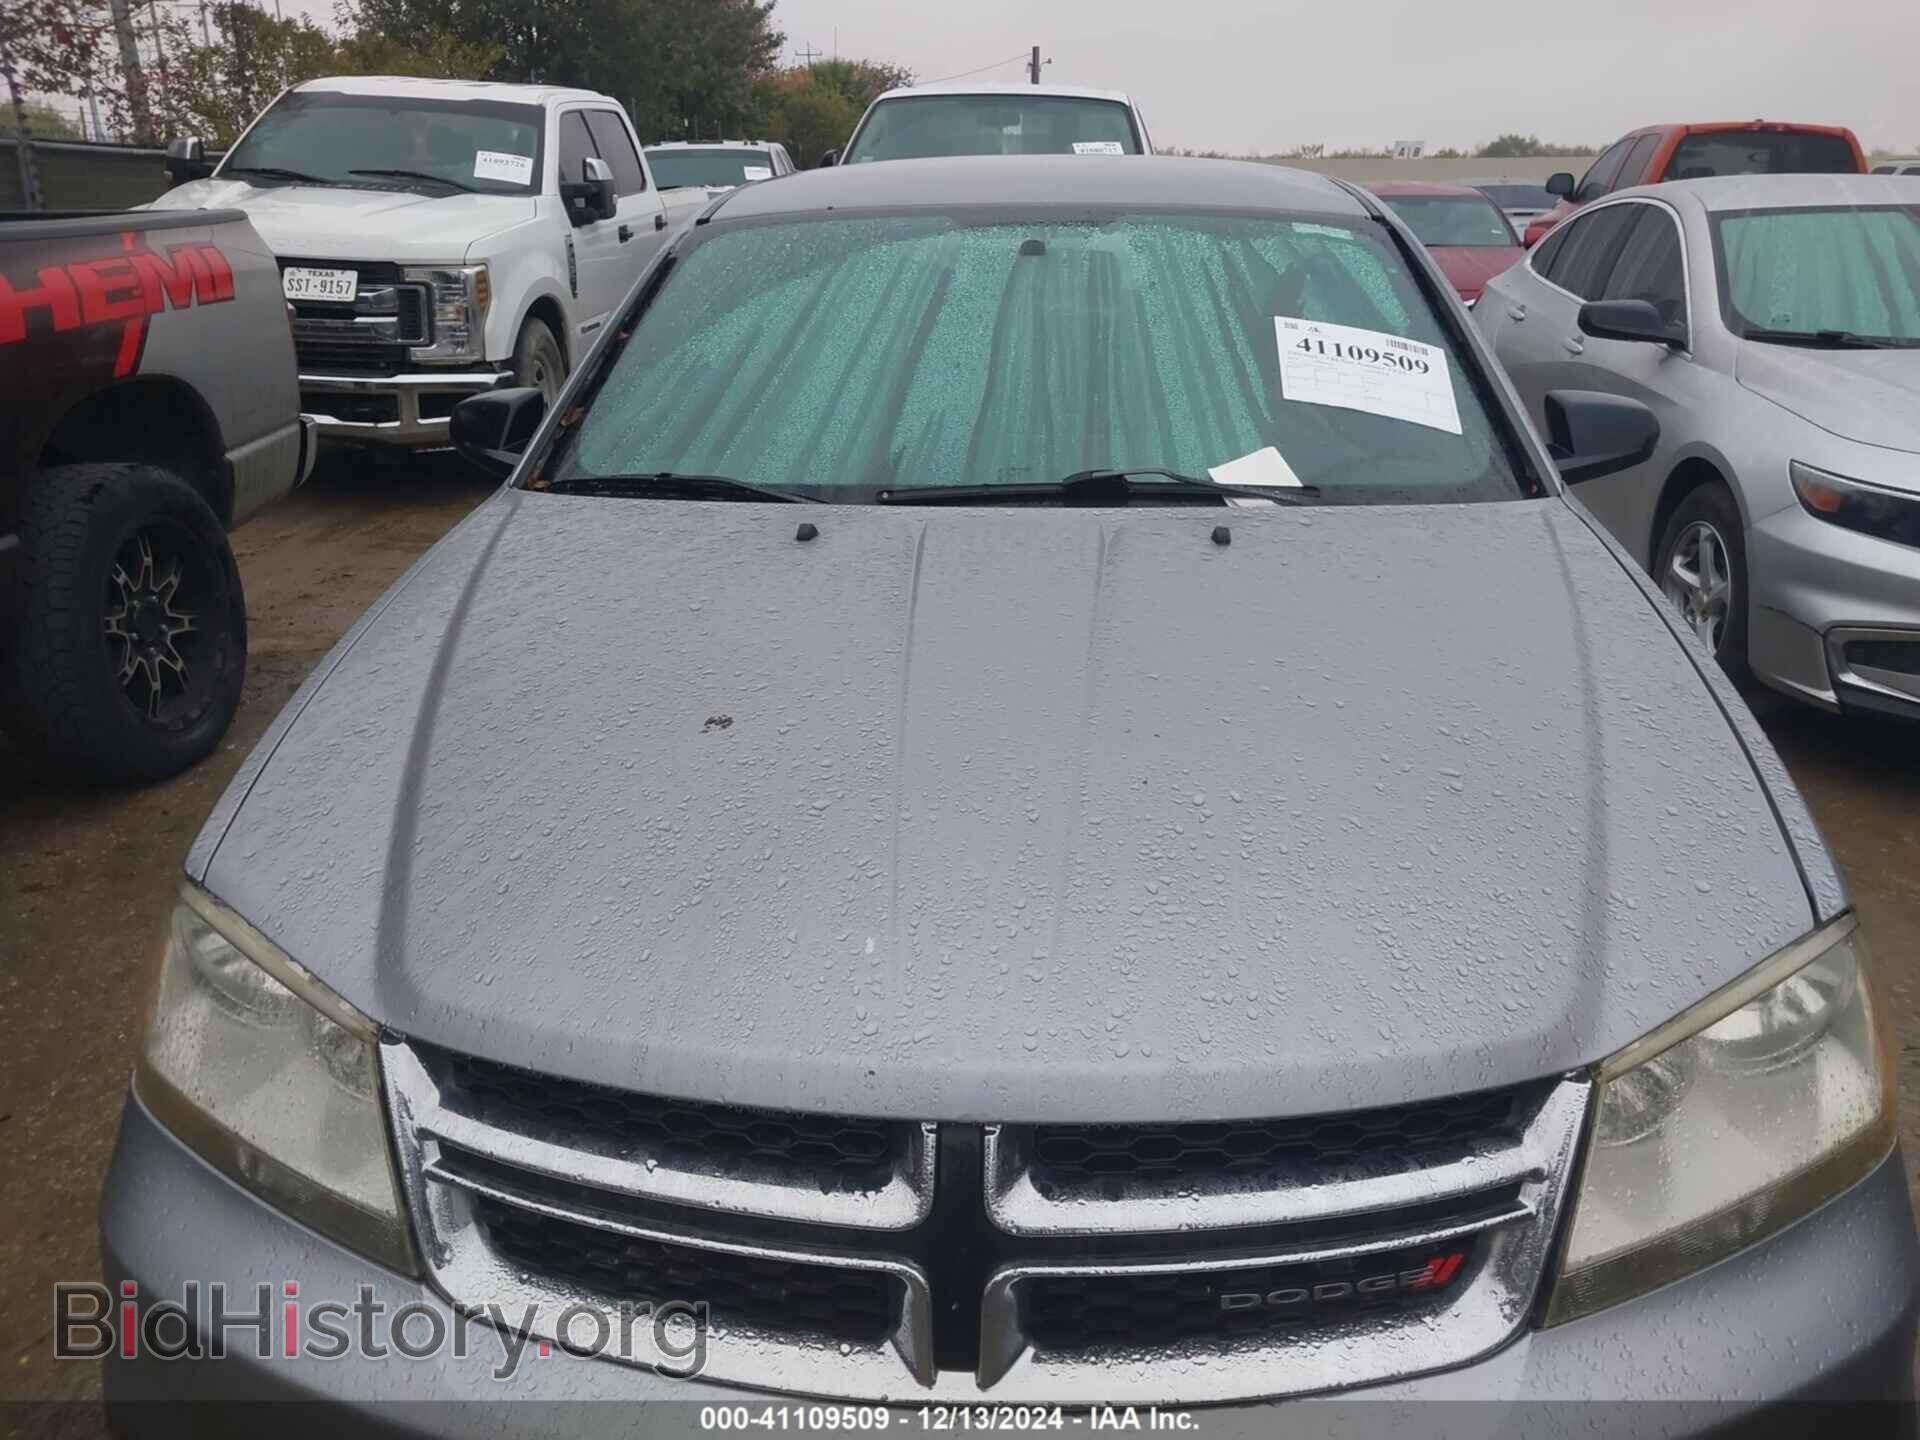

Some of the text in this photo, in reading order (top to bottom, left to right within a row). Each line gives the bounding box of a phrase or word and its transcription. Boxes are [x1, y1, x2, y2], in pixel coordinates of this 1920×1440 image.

[0, 245, 235, 344] HEMI
[1296, 337, 1430, 375] 41109509
[1220, 1265, 1434, 1310] DODGE
